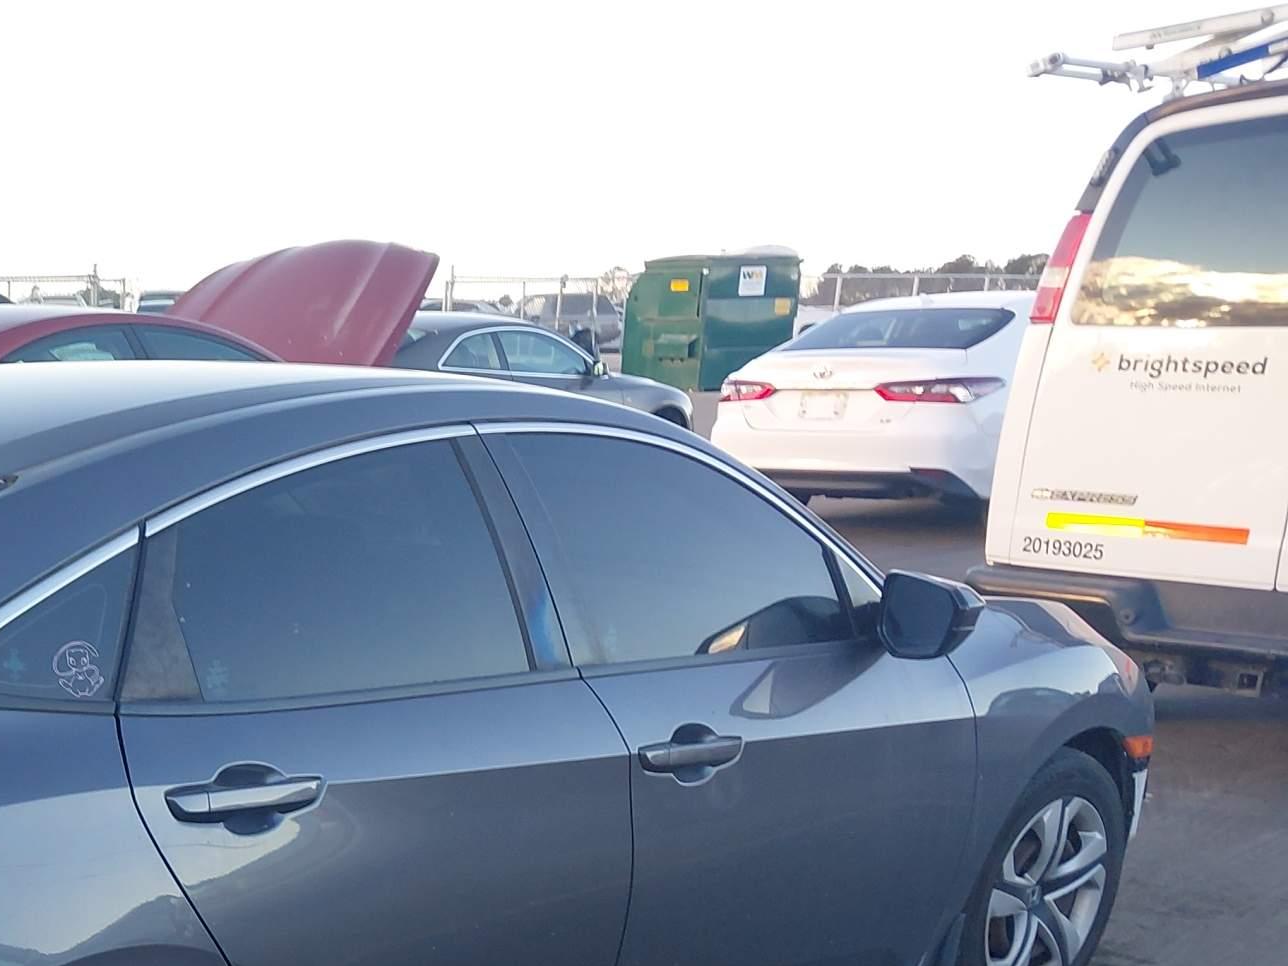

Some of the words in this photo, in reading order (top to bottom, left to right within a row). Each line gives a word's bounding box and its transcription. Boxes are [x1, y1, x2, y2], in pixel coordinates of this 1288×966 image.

[1118, 354, 1268, 378] brightspeed
[1129, 380, 1154, 392] High
[1158, 381, 1192, 392] Speed
[1195, 382, 1241, 393] Internet
[1022, 536, 1104, 560] 20193025
